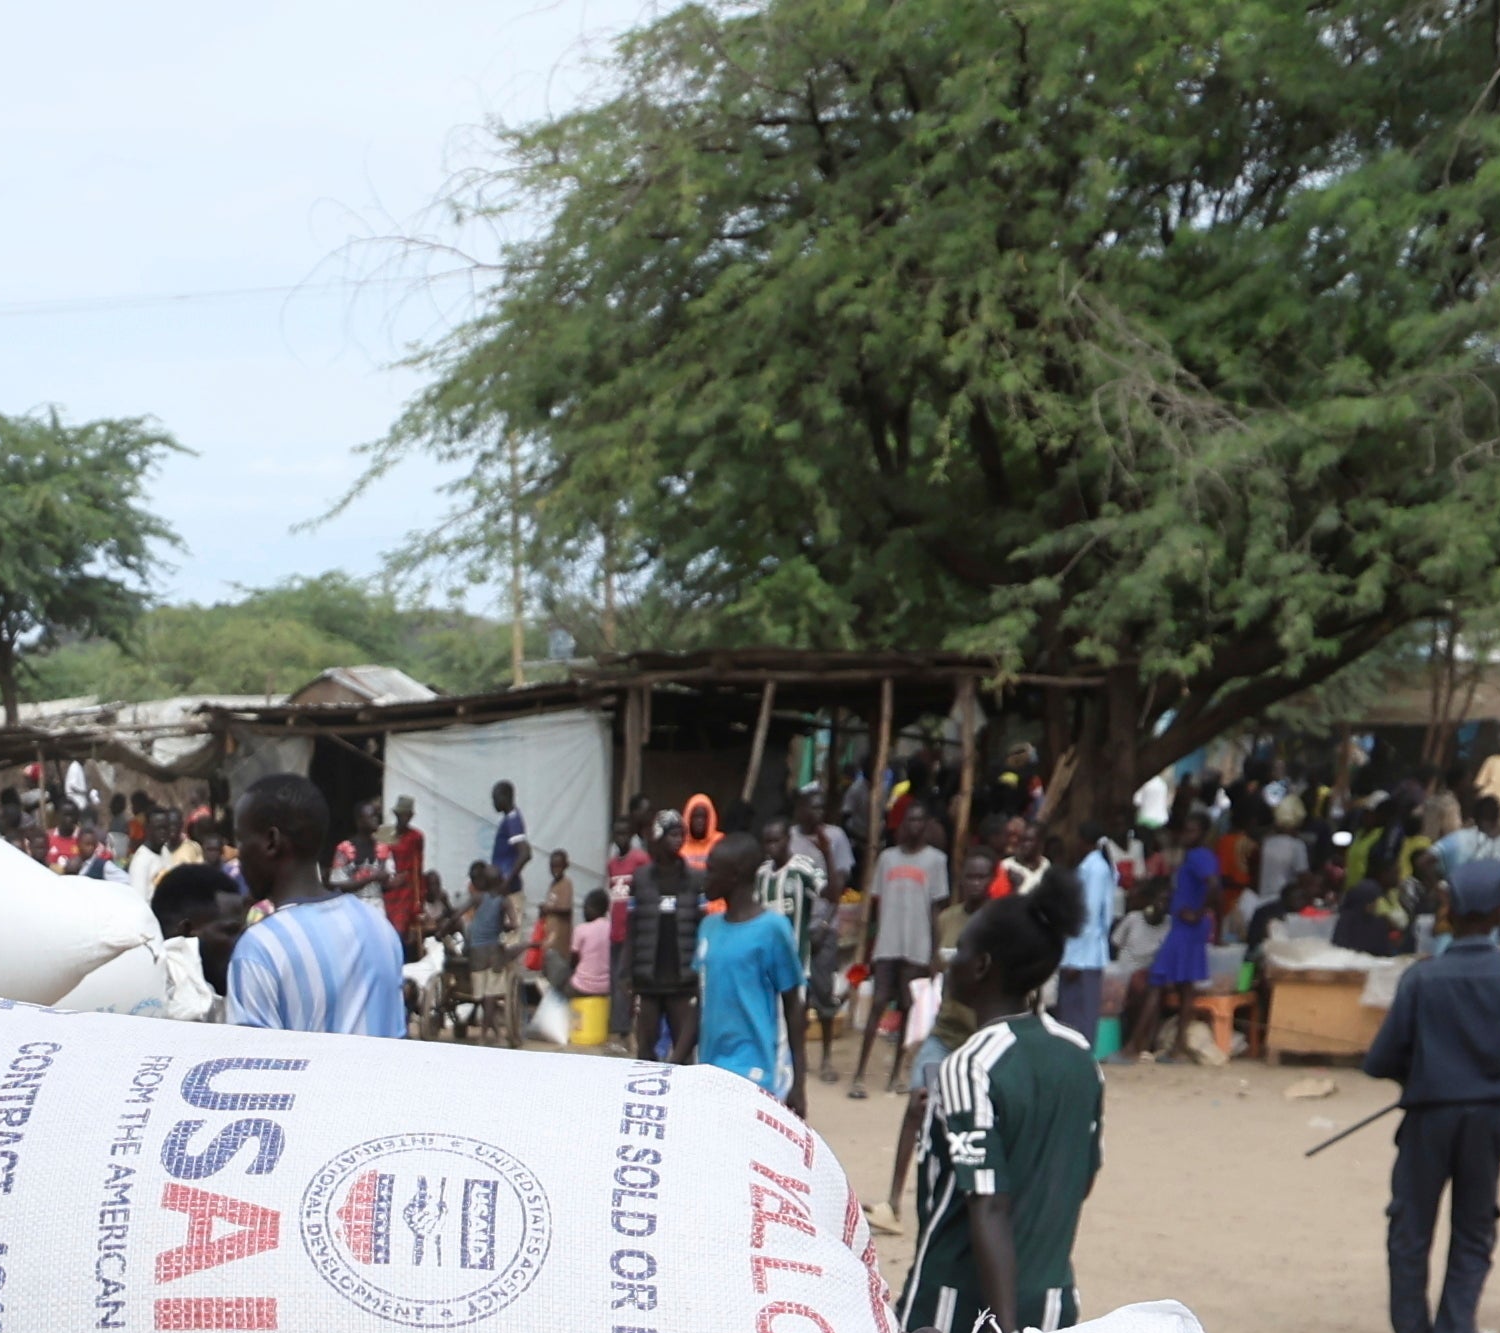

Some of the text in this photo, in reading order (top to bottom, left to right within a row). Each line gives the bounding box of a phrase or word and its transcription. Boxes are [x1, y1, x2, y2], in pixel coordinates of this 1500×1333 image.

[126, 1055, 174, 1104] FROM
[110, 1107, 152, 1157] THE
[619, 1101, 668, 1140] BE
[610, 1143, 663, 1238] SOLD
[95, 1162, 138, 1330] AMERICAN
[467, 1144, 547, 1318] UNITED STATES AGENCY
[305, 1222, 425, 1322] DEVELOPMENT
[608, 1248, 659, 1312] OR
